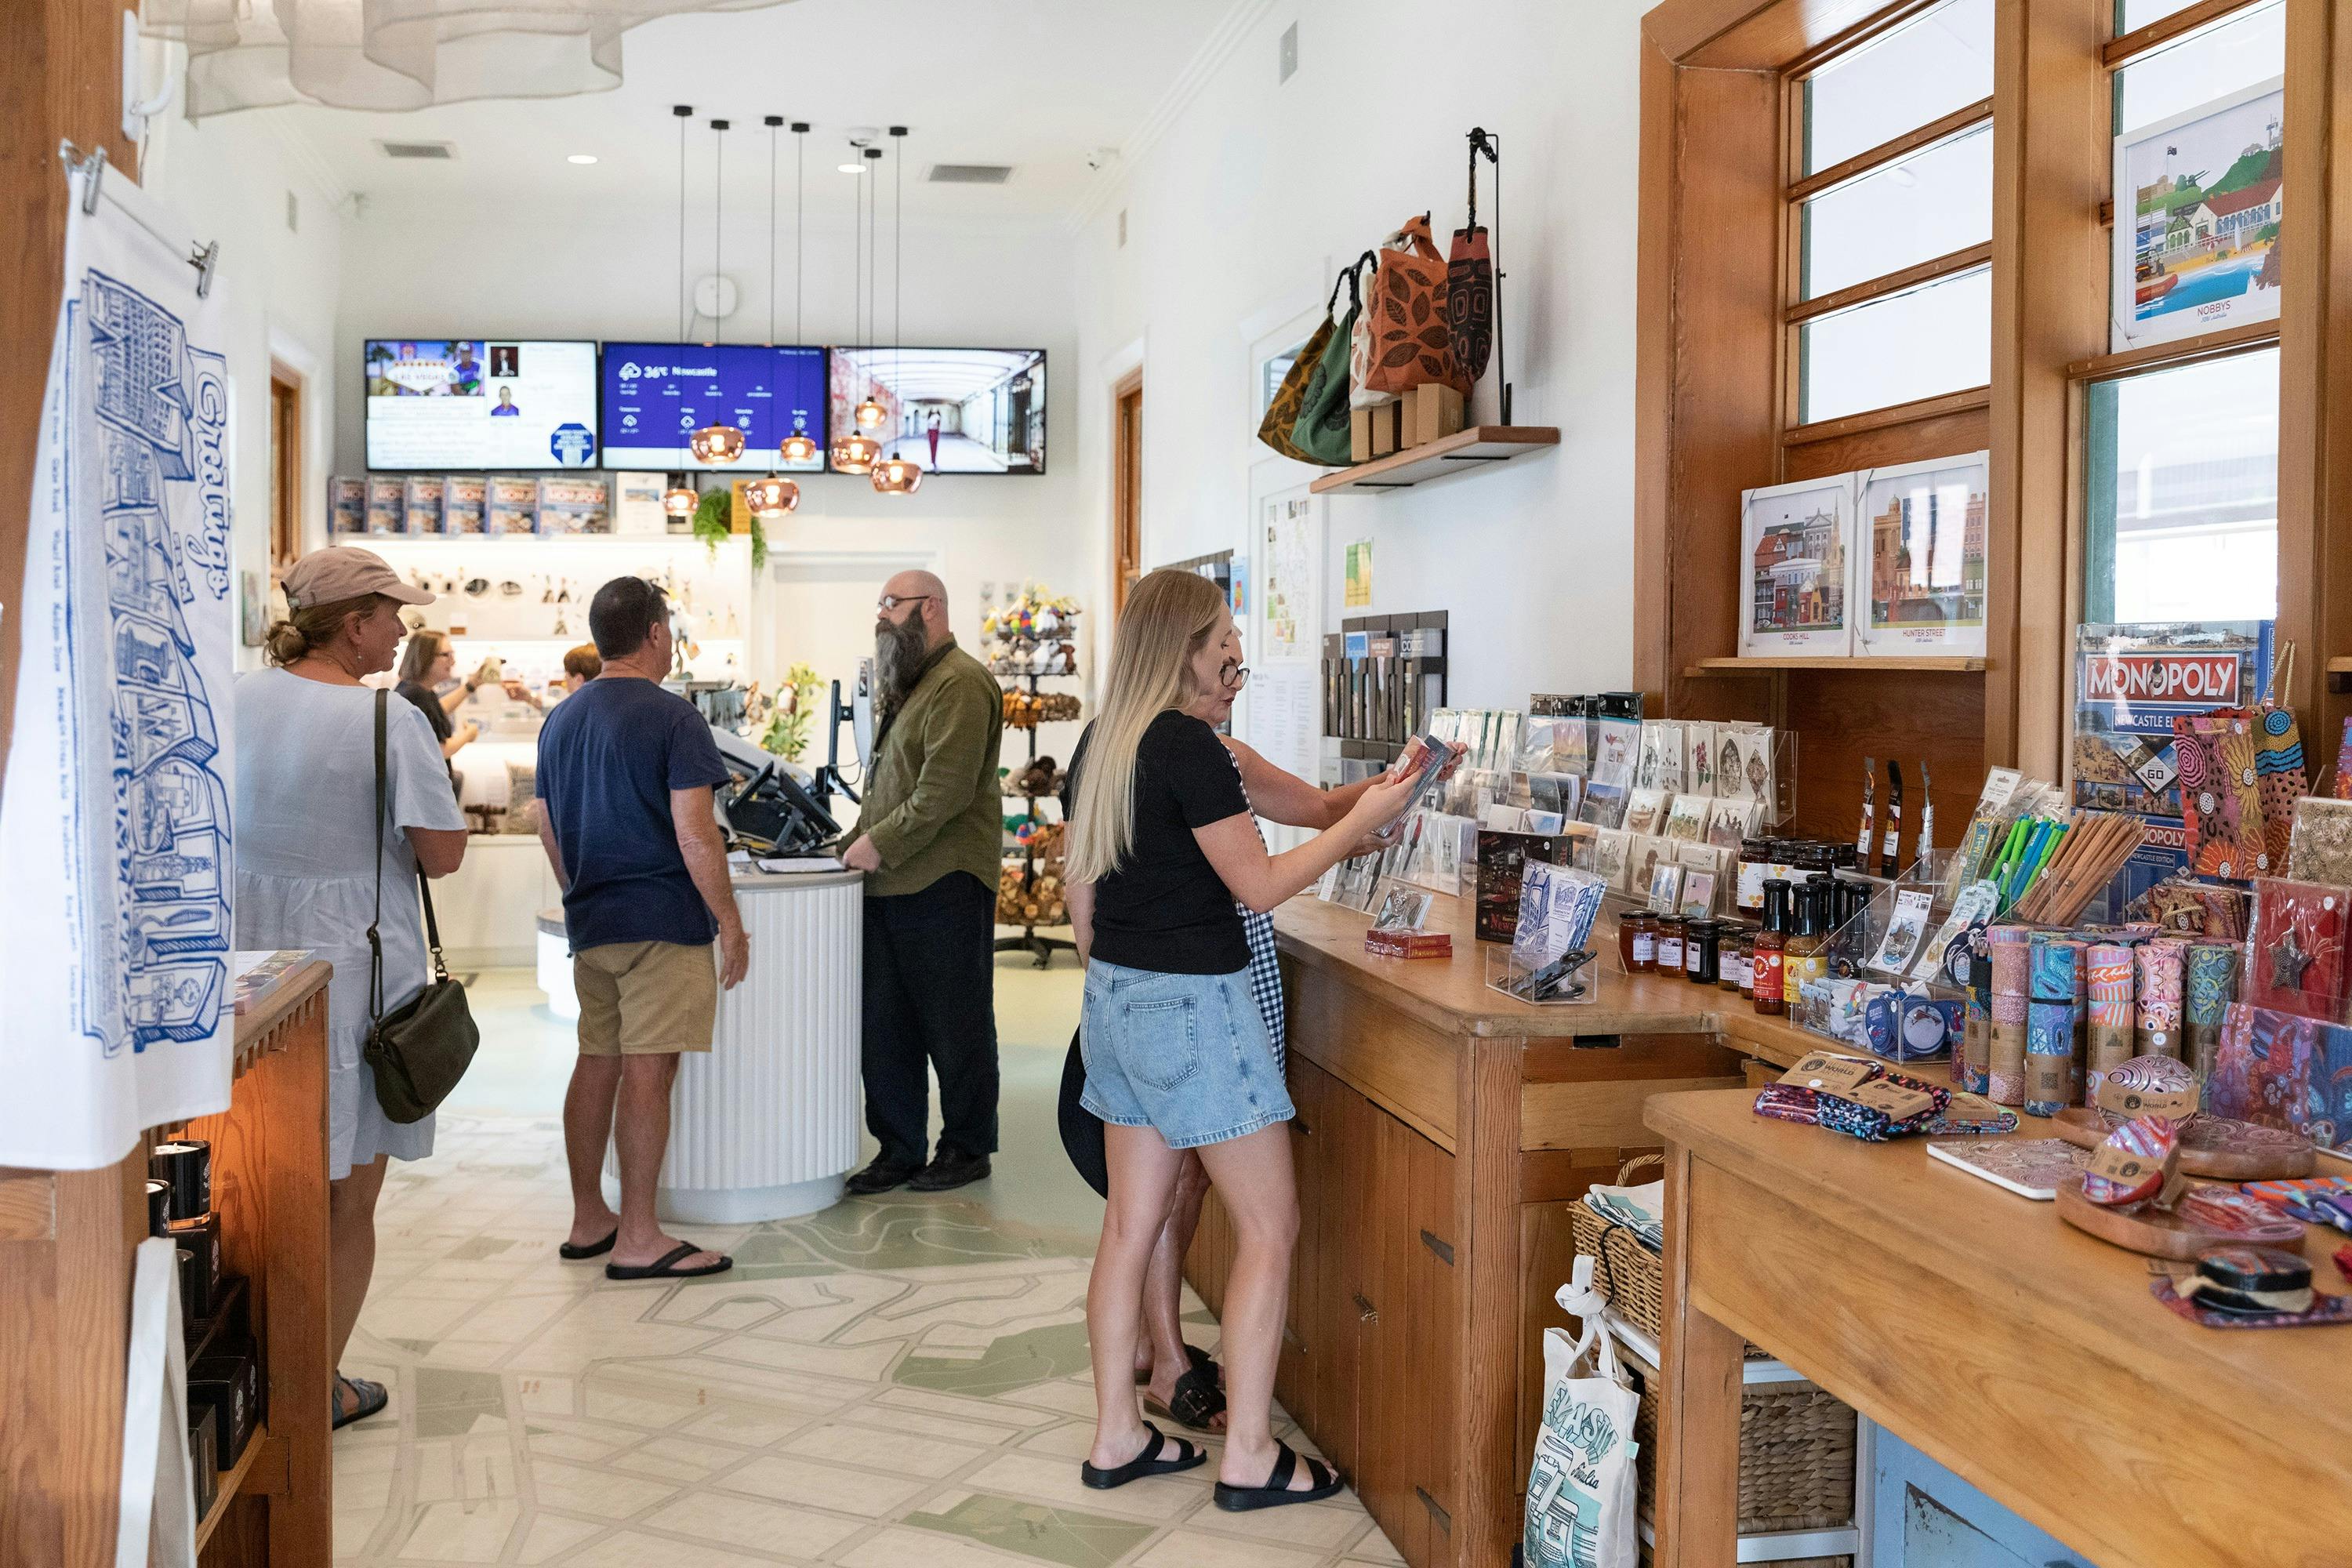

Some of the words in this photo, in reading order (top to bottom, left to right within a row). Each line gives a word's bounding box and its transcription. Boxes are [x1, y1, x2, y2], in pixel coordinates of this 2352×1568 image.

[2198, 301, 2230, 317] NOBBYS
[672, 366, 717, 377] Newcastle
[186, 372, 231, 602] Greetings
[2089, 662, 2234, 697] MONOPOLY
[2114, 715, 2162, 728] NEWCASTLE
[2148, 770, 2163, 779] GO
[2132, 853, 2155, 862] NEWCASTLE
[1825, 1065, 1855, 1076] WORLD
